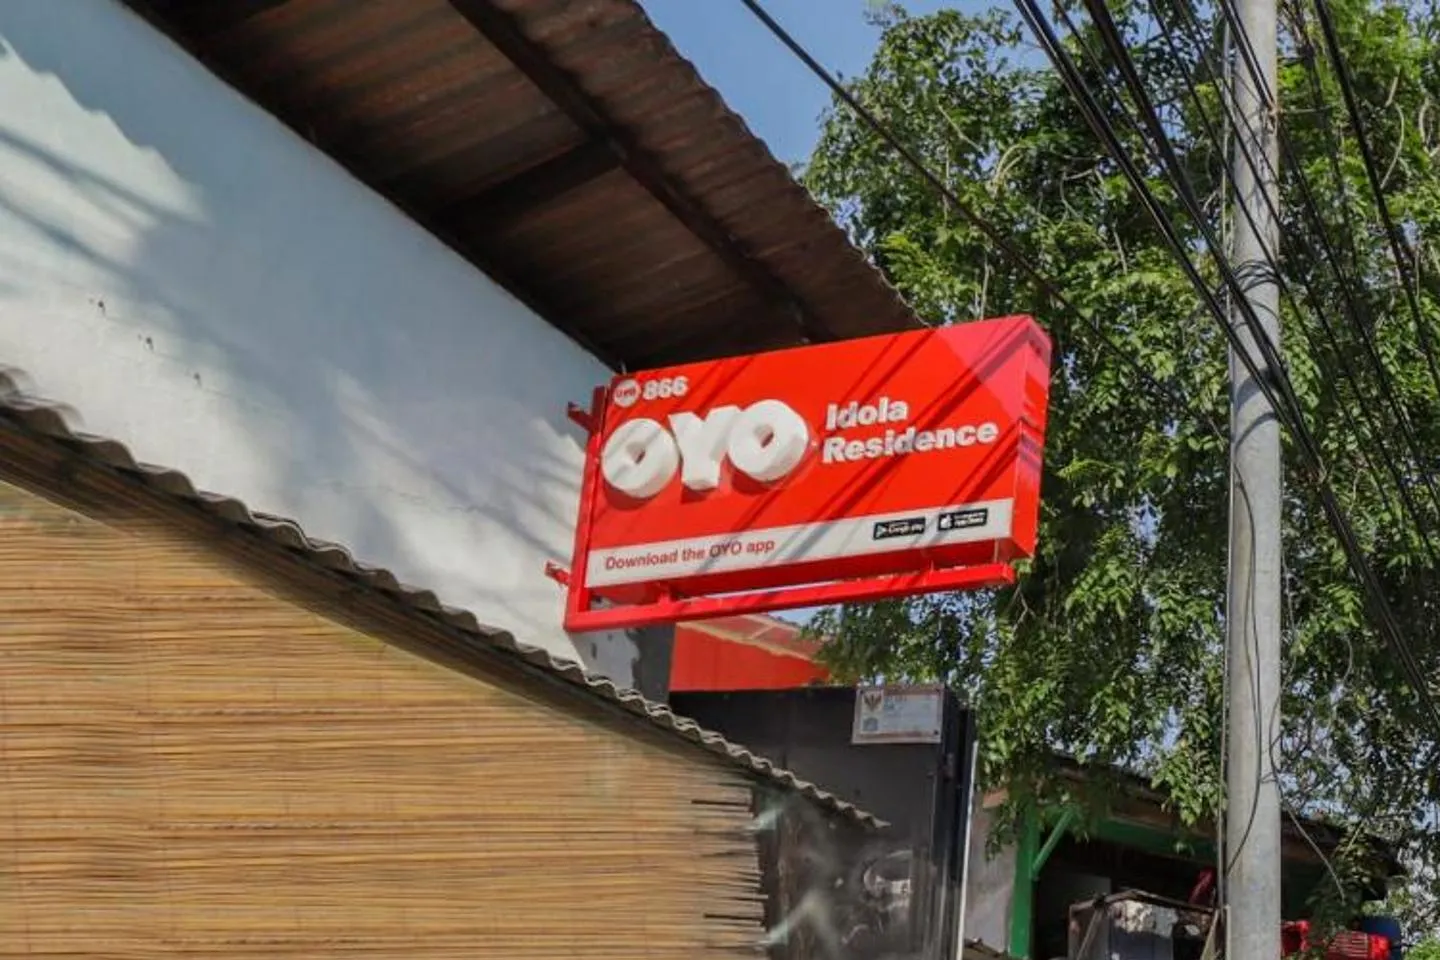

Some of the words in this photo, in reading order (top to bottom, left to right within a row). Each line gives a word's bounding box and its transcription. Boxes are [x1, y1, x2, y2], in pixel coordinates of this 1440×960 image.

[642, 375, 689, 400] 866
[826, 396, 909, 431] Idola
[601, 399, 809, 498] OYO
[822, 421, 999, 464] Residence
[605, 549, 678, 571] Download
[682, 548, 706, 561] the
[708, 541, 742, 558] OYO
[746, 539, 776, 554] app
